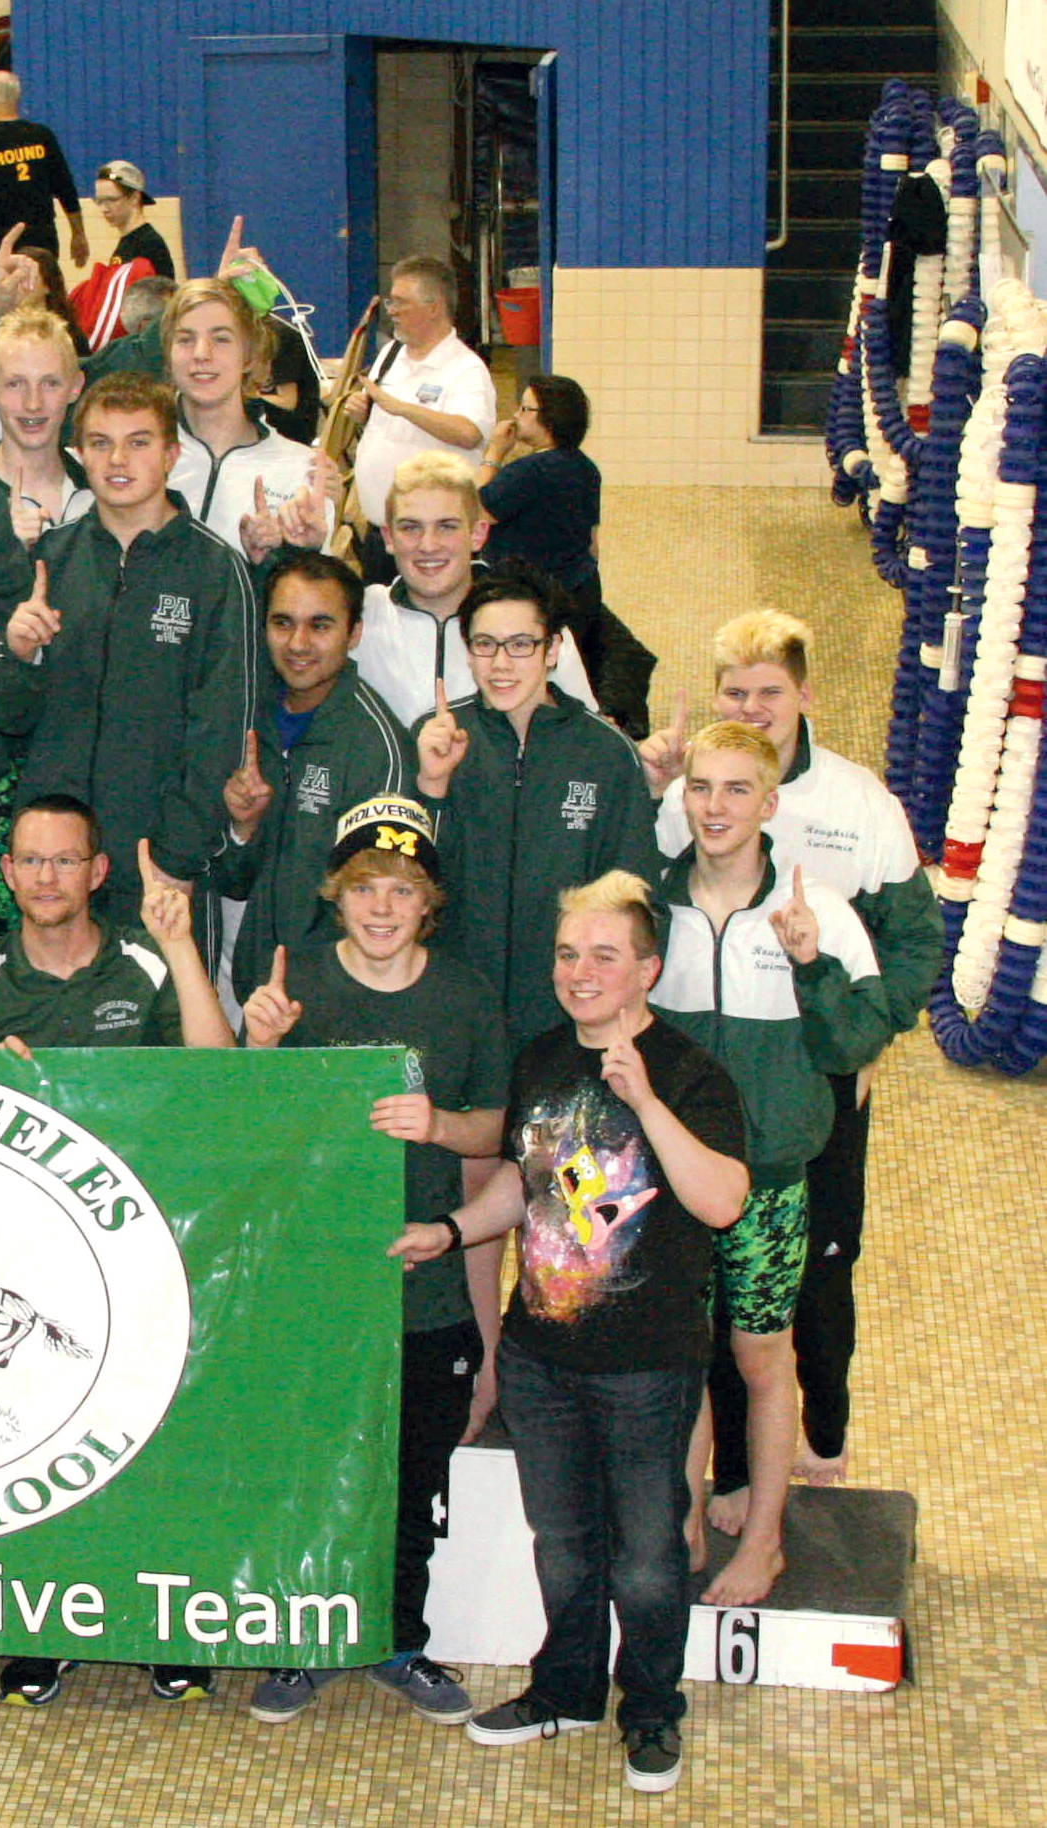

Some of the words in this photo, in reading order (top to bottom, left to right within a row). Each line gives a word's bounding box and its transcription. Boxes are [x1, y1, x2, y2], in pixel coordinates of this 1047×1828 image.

[16, 162, 31, 181] 2
[157, 594, 191, 620] PA
[567, 781, 597, 805] PA
[375, 825, 418, 857] M
[136, 1571, 360, 1646] Team
[718, 1609, 757, 1685] 6
